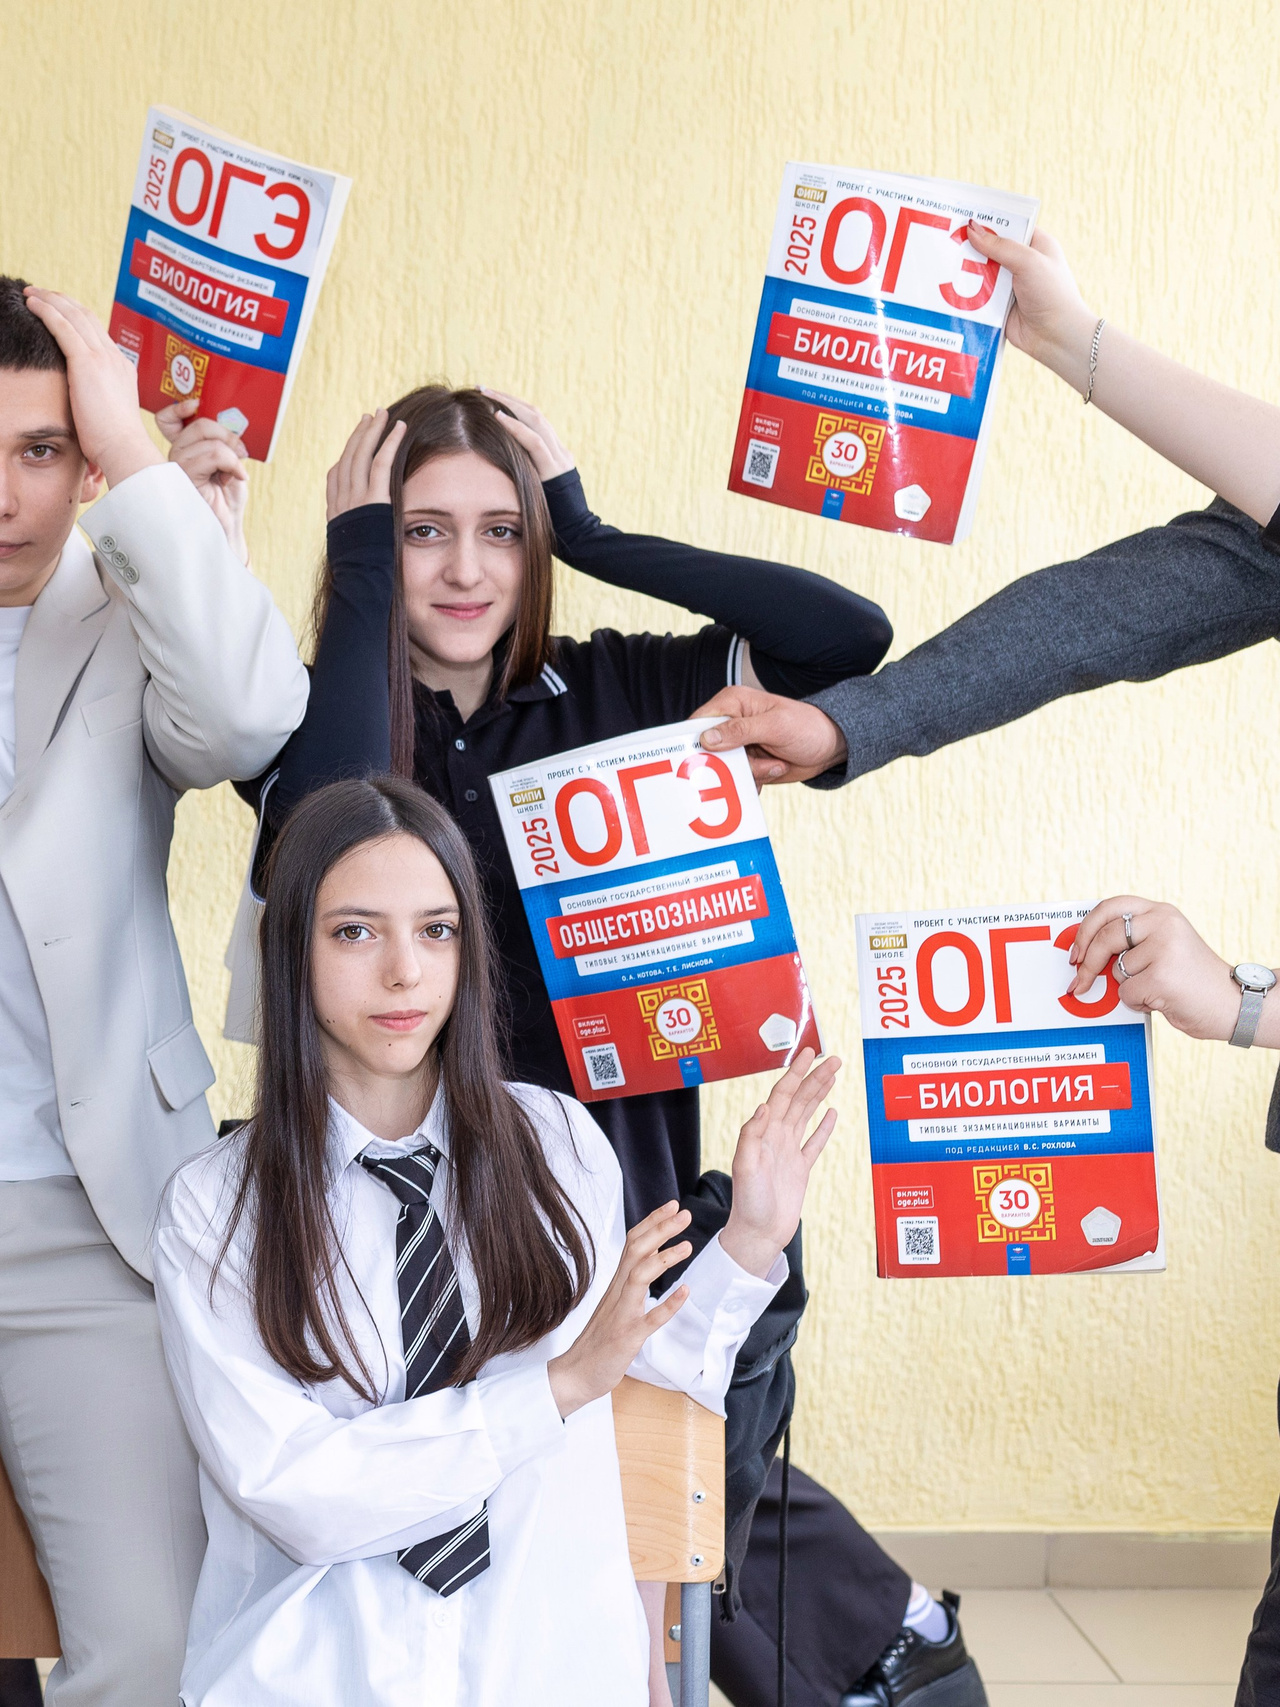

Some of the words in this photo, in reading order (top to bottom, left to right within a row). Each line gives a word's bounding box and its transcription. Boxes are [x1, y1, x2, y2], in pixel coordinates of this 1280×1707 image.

[144, 155, 166, 210] 2025
[795, 186, 824, 201] ФИПИ
[168, 147, 310, 260] ОГЭ
[794, 200, 820, 211] ШКОЛЕ
[835, 179, 864, 192] ПРОЕКТ
[875, 187, 913, 203] УЧАСТИЕМ
[915, 197, 974, 217] РАЗРАБОТЧИКОВ
[977, 214, 993, 222] КИМ
[998, 217, 1010, 227] ОГЭ
[784, 214, 816, 275] 2025
[820, 197, 1001, 311] ОГЭ
[150, 256, 260, 322] БИОЛОГИЯ
[796, 305, 835, 320] ОСНОВНОЙ
[919, 332, 956, 346] ЭКЗАМЕН
[794, 327, 946, 382] БИОЛОГИЯ
[174, 362, 190, 382] 30
[786, 365, 818, 379] ТИПОВЫЕ
[820, 372, 896, 397] ЭКЗАМЕНАЦИОНН
[899, 389, 940, 405] ВАРИАНТЫ
[801, 389, 816, 399] ПОД
[818, 392, 864, 409] РЕДАКЦИЕЙ
[830, 439, 859, 462] 30
[546, 767, 575, 780] ПРОЕКТ
[577, 765, 583, 773] С
[585, 755, 625, 771] УАСТИЕМ
[512, 789, 542, 804] ФИПИ
[517, 803, 544, 814] ШКОЛЕ
[554, 753, 742, 866] ОГЭ
[522, 817, 559, 876] 2025
[566, 894, 607, 910] ОСНОВНОЙ
[609, 876, 690, 901] ГОСУДАРСТВЕННЫЙ
[693, 868, 731, 883] ЭКЗАМЕН
[559, 886, 756, 950] ОБЩЕСТВОЗНАНИЕ
[913, 918, 944, 927] ПРОЕКТ
[956, 915, 999, 925] УЧАСТИЕМ
[1004, 911, 1072, 922] РАЗРАБОТЧИКОВ
[1076, 909, 1090, 917] КИ
[584, 955, 618, 969] ТИПОВЫЕ
[620, 939, 697, 963] ЭКЗАМЕНАЦИОННЫЕ
[701, 929, 743, 945] ВАРИАНТЫ
[872, 936, 904, 948] ФИПИ
[637, 967, 664, 980] КОТОВА,
[680, 957, 713, 970] ЛИСКОВА
[877, 966, 910, 1030] 2025
[662, 1006, 692, 1029] 30
[668, 1026, 694, 1036] ВАРИАНТОВ
[910, 1058, 957, 1069] ОСНОВНОЙ
[961, 1052, 1050, 1066] ГОСУДАРСТВЕННЫЙ
[1054, 1051, 1097, 1061] ЭКЗАМЕН
[920, 1074, 1094, 1110] БИОЛОГИЯ
[919, 1125, 957, 1135] ТИПОВЫЕ
[962, 1119, 1048, 1133] ЭКЗАМЕНАЦИОННЫЕ
[1053, 1117, 1099, 1127] ВАРИАНТЫ
[945, 1146, 963, 1155] ПОД
[966, 1142, 1019, 1154] РЕДАКЦИЕЙ
[1041, 1140, 1076, 1149] РОХЛОВА
[897, 1196, 929, 1207] oge.plus
[999, 1189, 1029, 1210] 30
